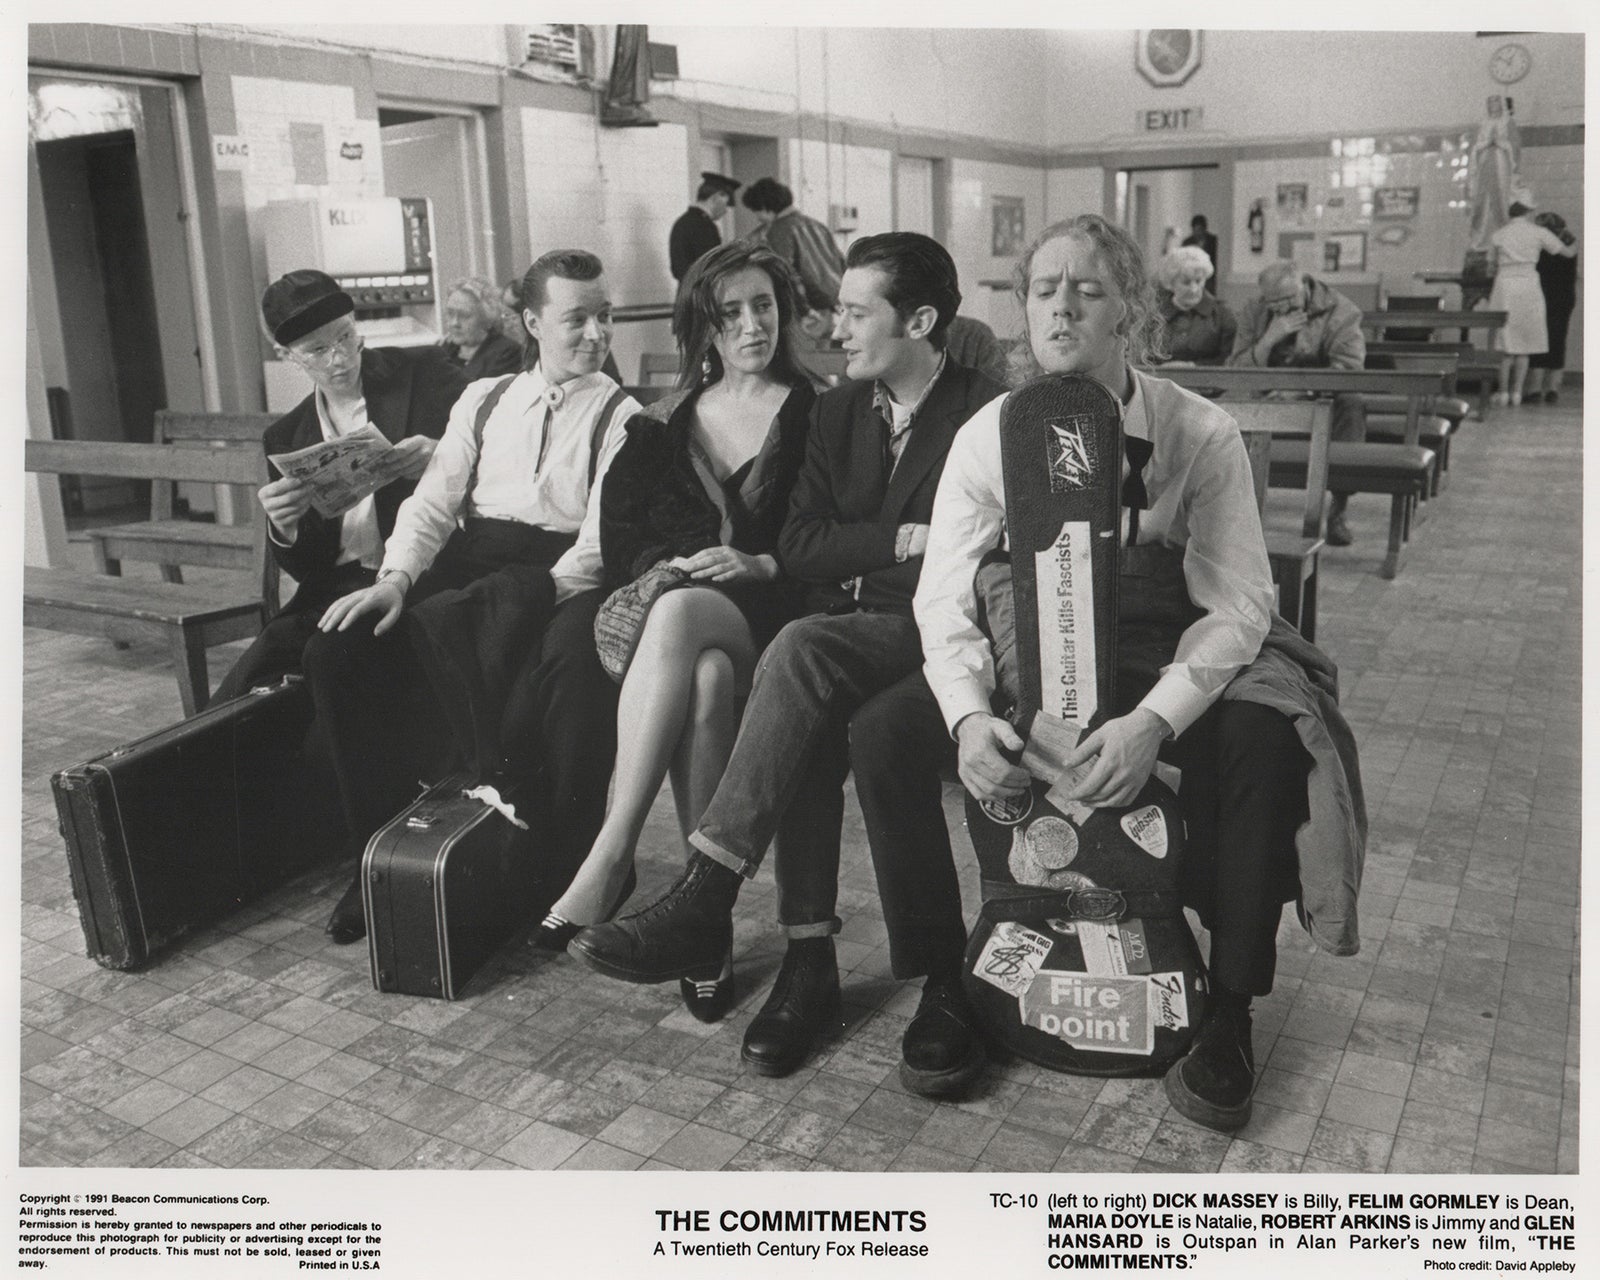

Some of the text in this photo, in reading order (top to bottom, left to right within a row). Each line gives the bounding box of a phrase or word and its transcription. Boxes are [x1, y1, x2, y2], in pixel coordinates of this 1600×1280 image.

[1145, 108, 1190, 130] EXIT
[1050, 418, 1092, 486] PEAVEY
[1055, 532, 1079, 720] This Guitar Kills Fascists
[1050, 976, 1120, 1009] Fire
[1150, 975, 1182, 1029] Fender
[1040, 1011, 1130, 1042] point
